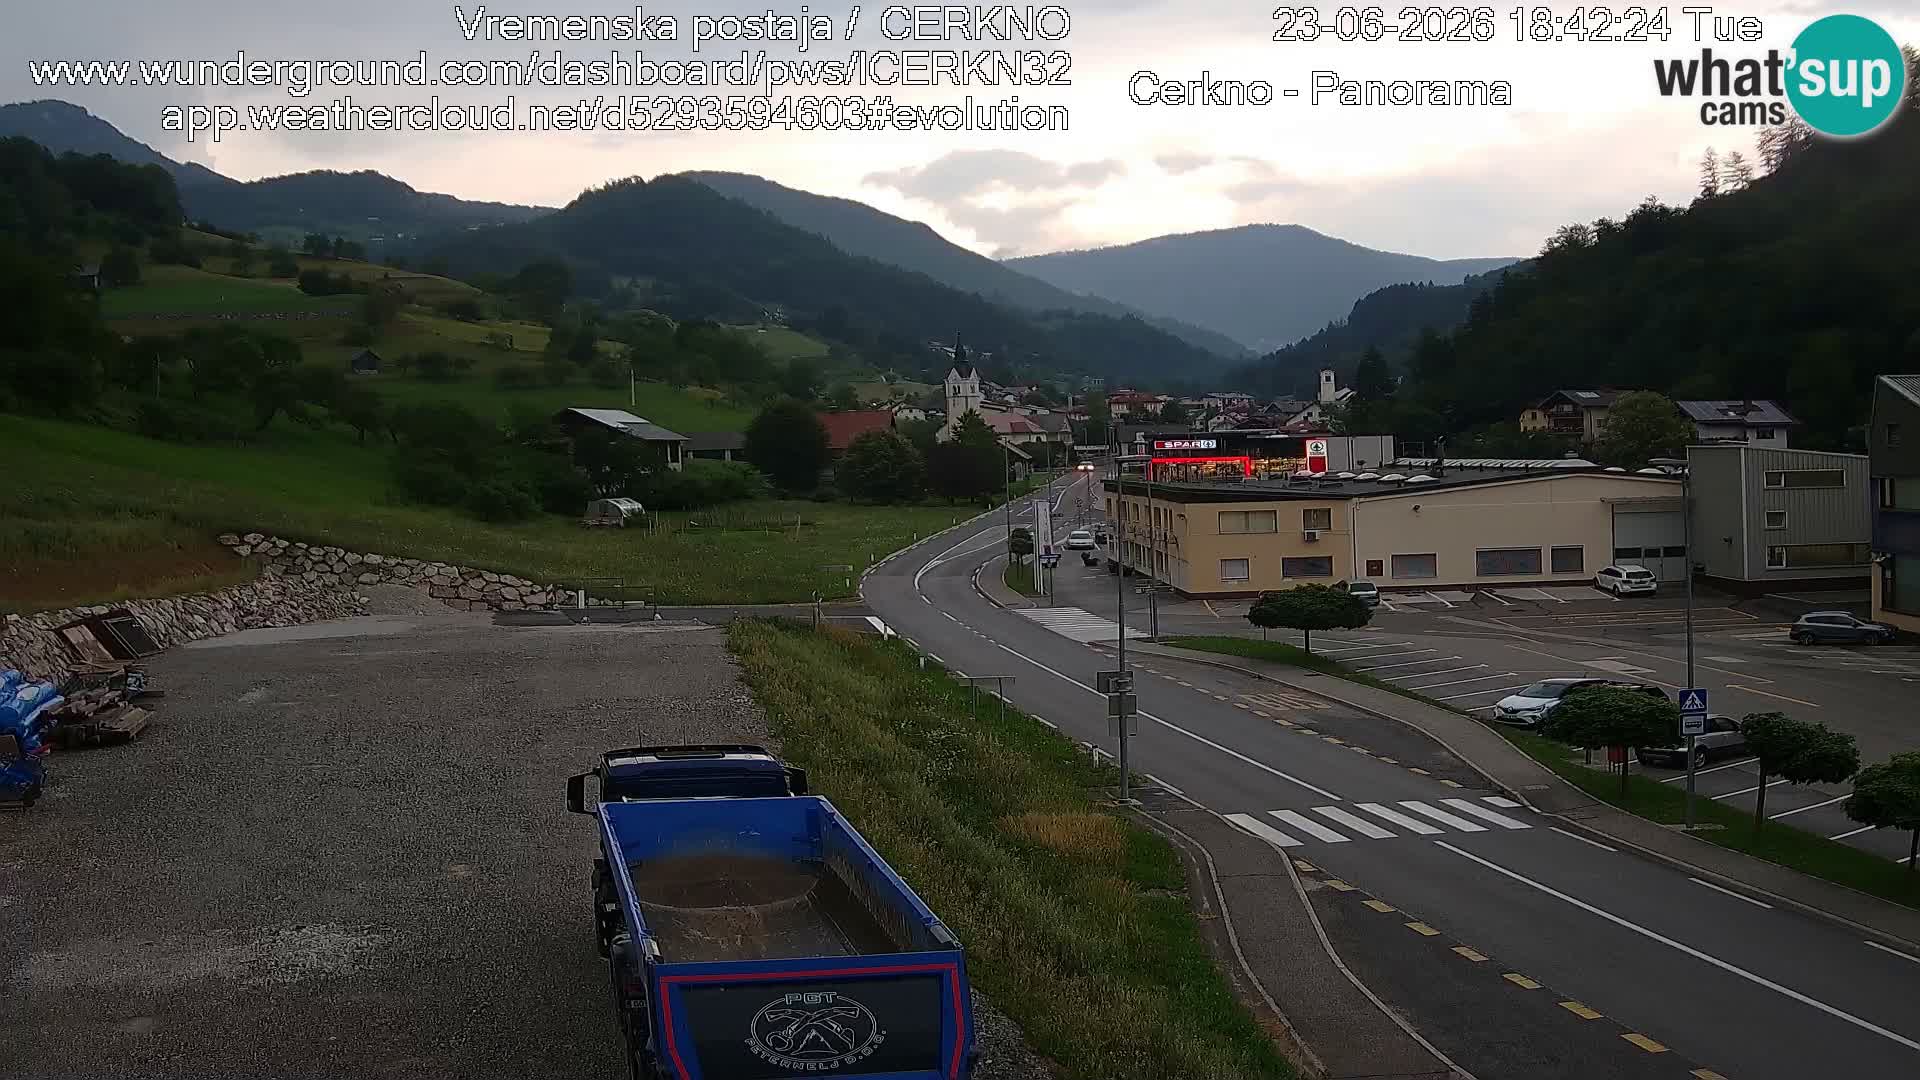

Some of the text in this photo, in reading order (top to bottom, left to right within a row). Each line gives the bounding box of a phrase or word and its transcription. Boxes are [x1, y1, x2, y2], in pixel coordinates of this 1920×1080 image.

[1164, 440, 1201, 449] SPAR
[785, 991, 838, 1005] PGT
[744, 1037, 840, 1071] PETERNELJ
